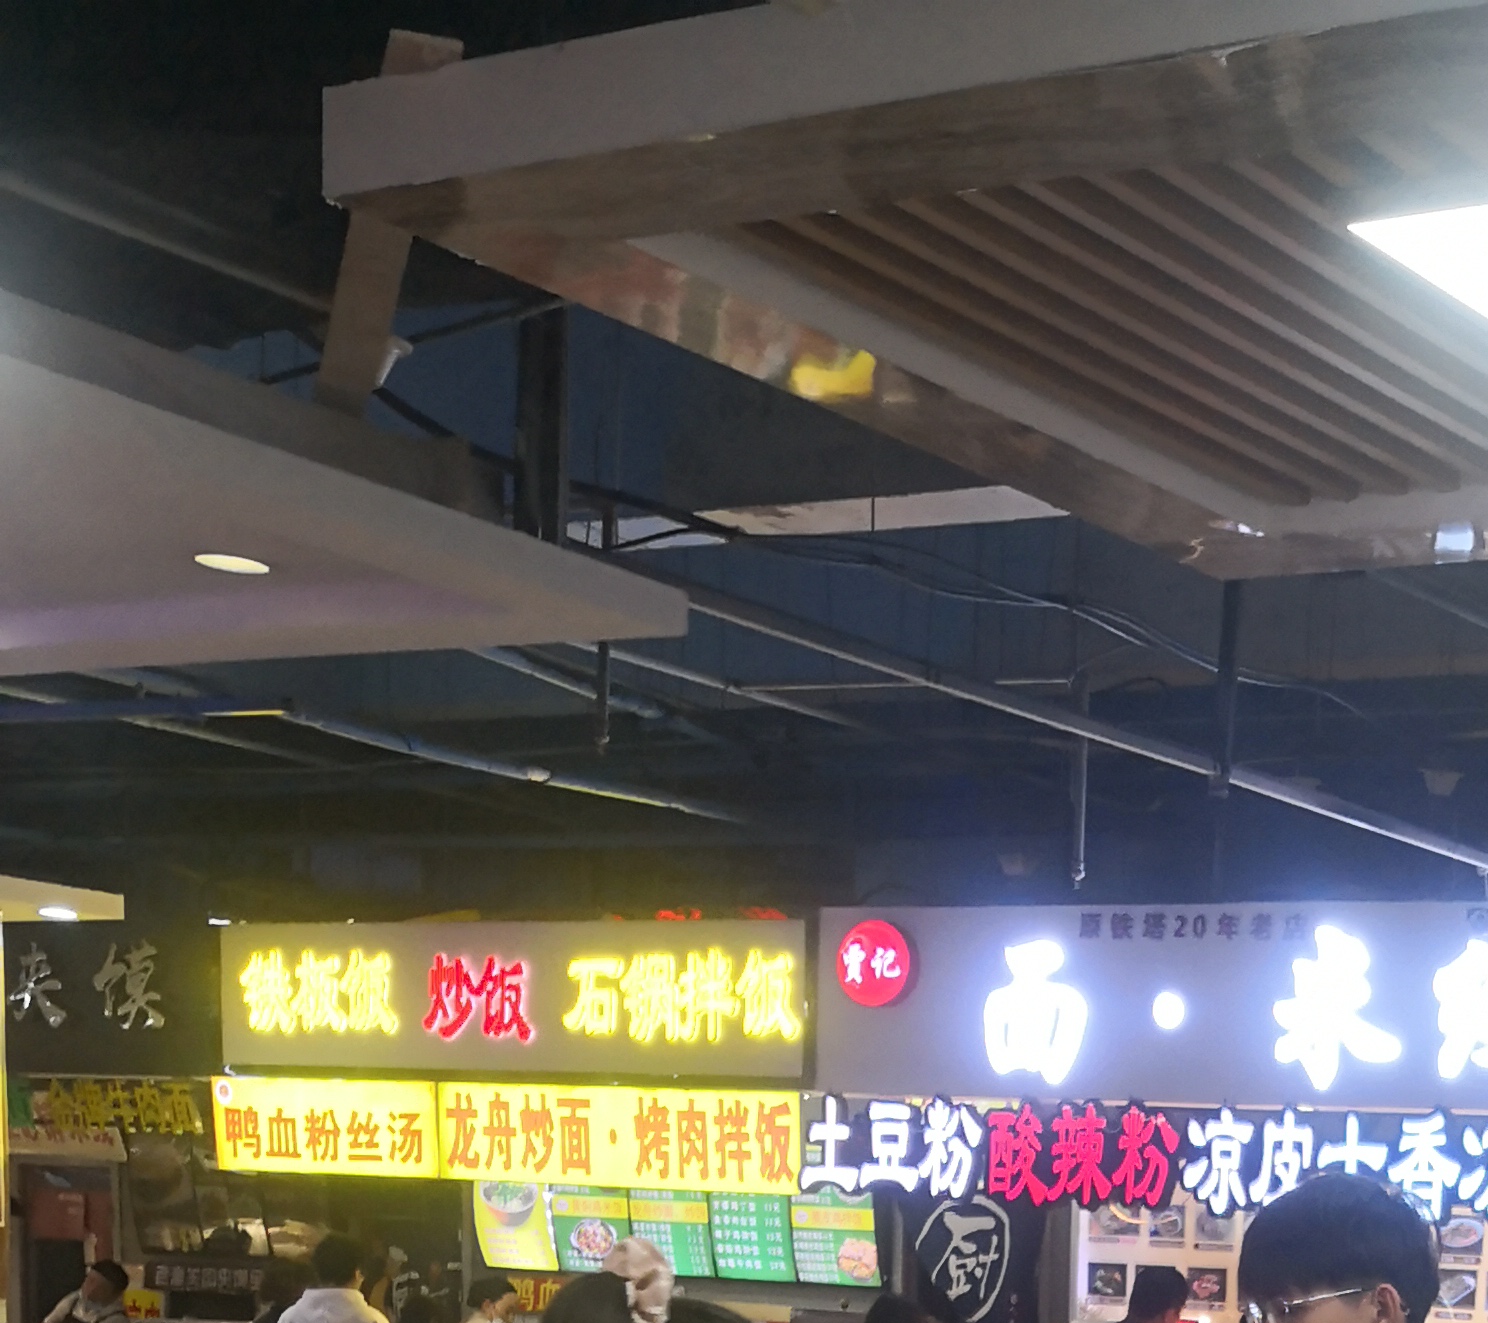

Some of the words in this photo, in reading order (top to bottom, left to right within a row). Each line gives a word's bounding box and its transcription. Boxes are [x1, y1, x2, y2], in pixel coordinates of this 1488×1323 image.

[239, 948, 400, 1036] 铁板饭
[422, 952, 536, 1045] 炒饭
[563, 947, 802, 1044] 石锅拌饭
[225, 1106, 423, 1164] 鸭血粉丝汤
[800, 1095, 983, 1199] 土豆粉
[987, 1102, 1181, 1207] 酸辣粉
